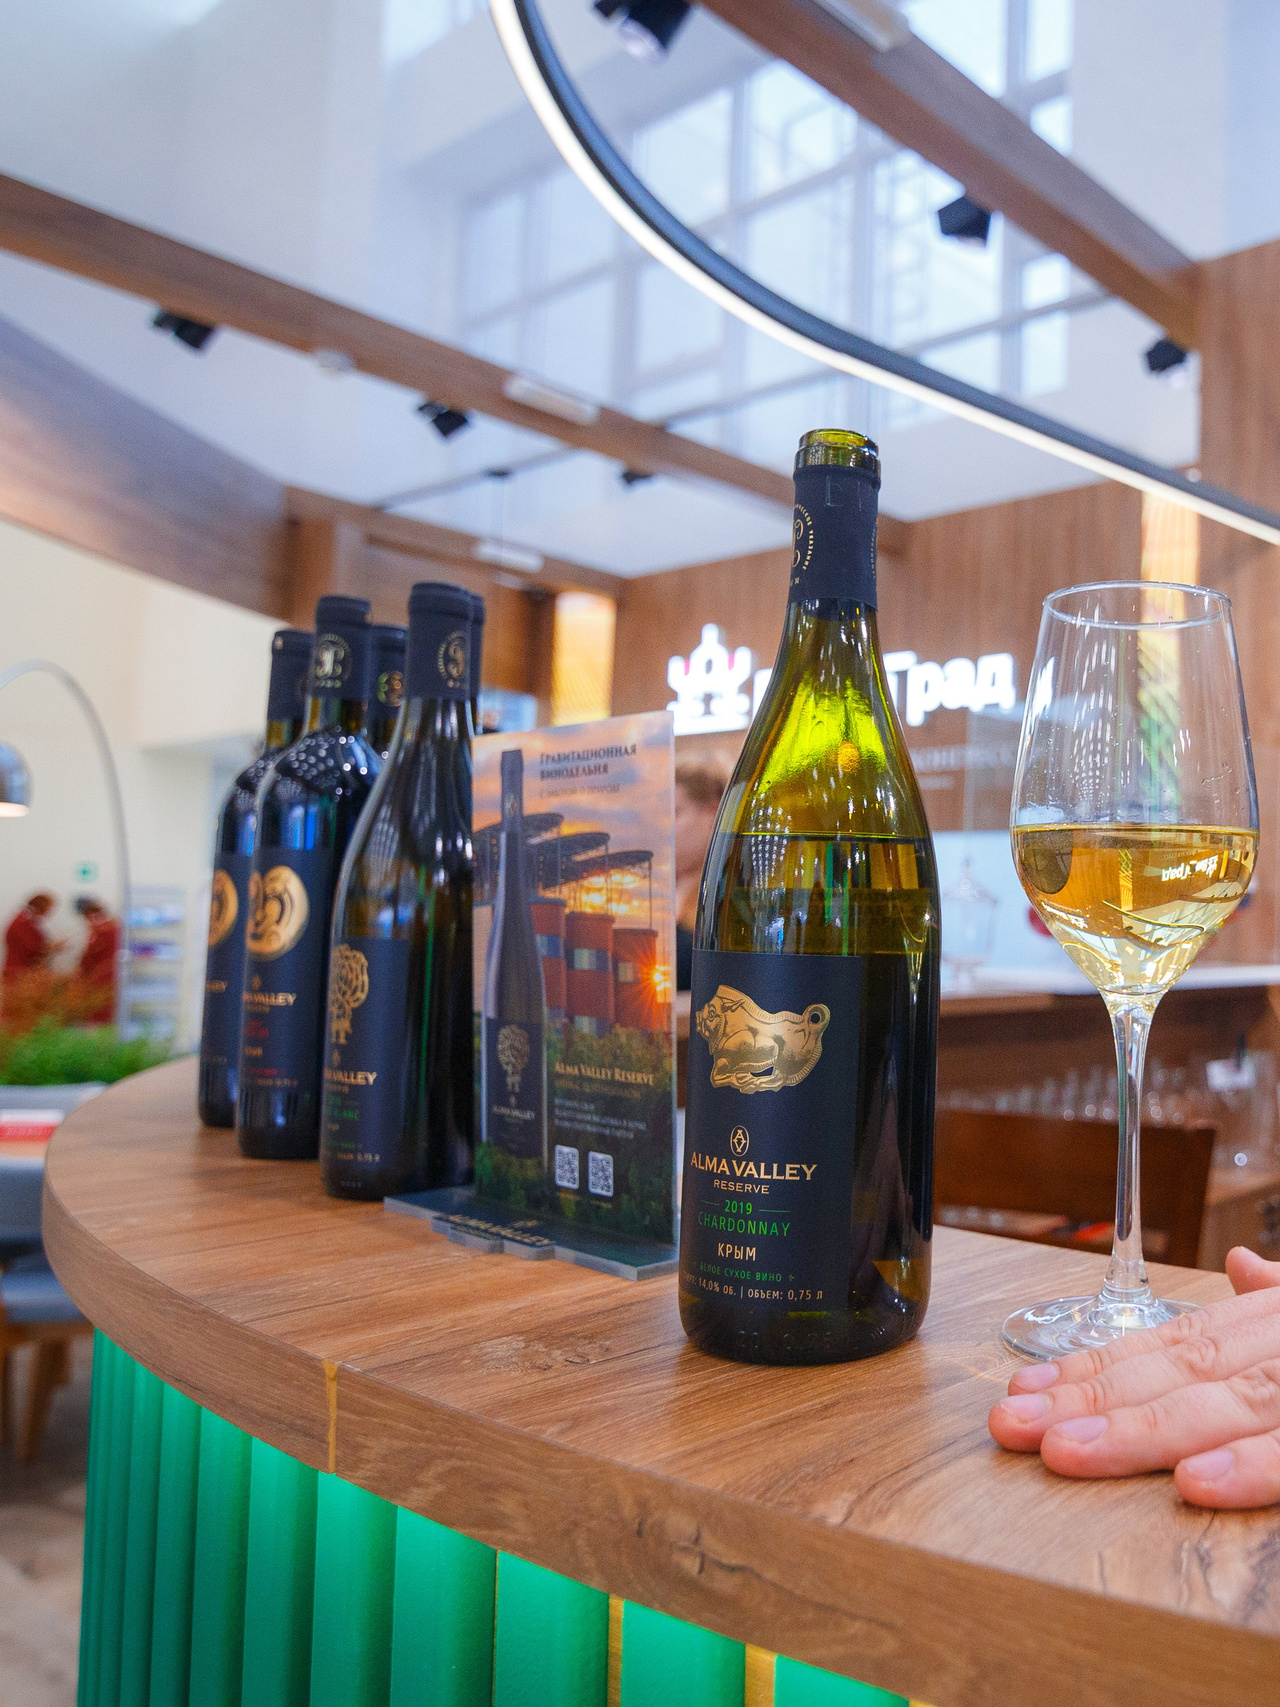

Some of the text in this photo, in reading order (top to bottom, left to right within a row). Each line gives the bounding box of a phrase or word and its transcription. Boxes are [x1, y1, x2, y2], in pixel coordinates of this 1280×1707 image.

[690, 1151, 818, 1181] ALMA VALLEY
[713, 1179, 770, 1195] RESERVE
[724, 1199, 753, 1215] 2019
[698, 1211, 791, 1237] CHARDONNAY
[717, 1242, 757, 1261] КРЫМ
[724, 1267, 752, 1280] СУХОЕ
[755, 1273, 782, 1282] ВИНО
[747, 1288, 784, 1300] ОБЪЕМ:
[787, 1289, 812, 1301] 0,75
